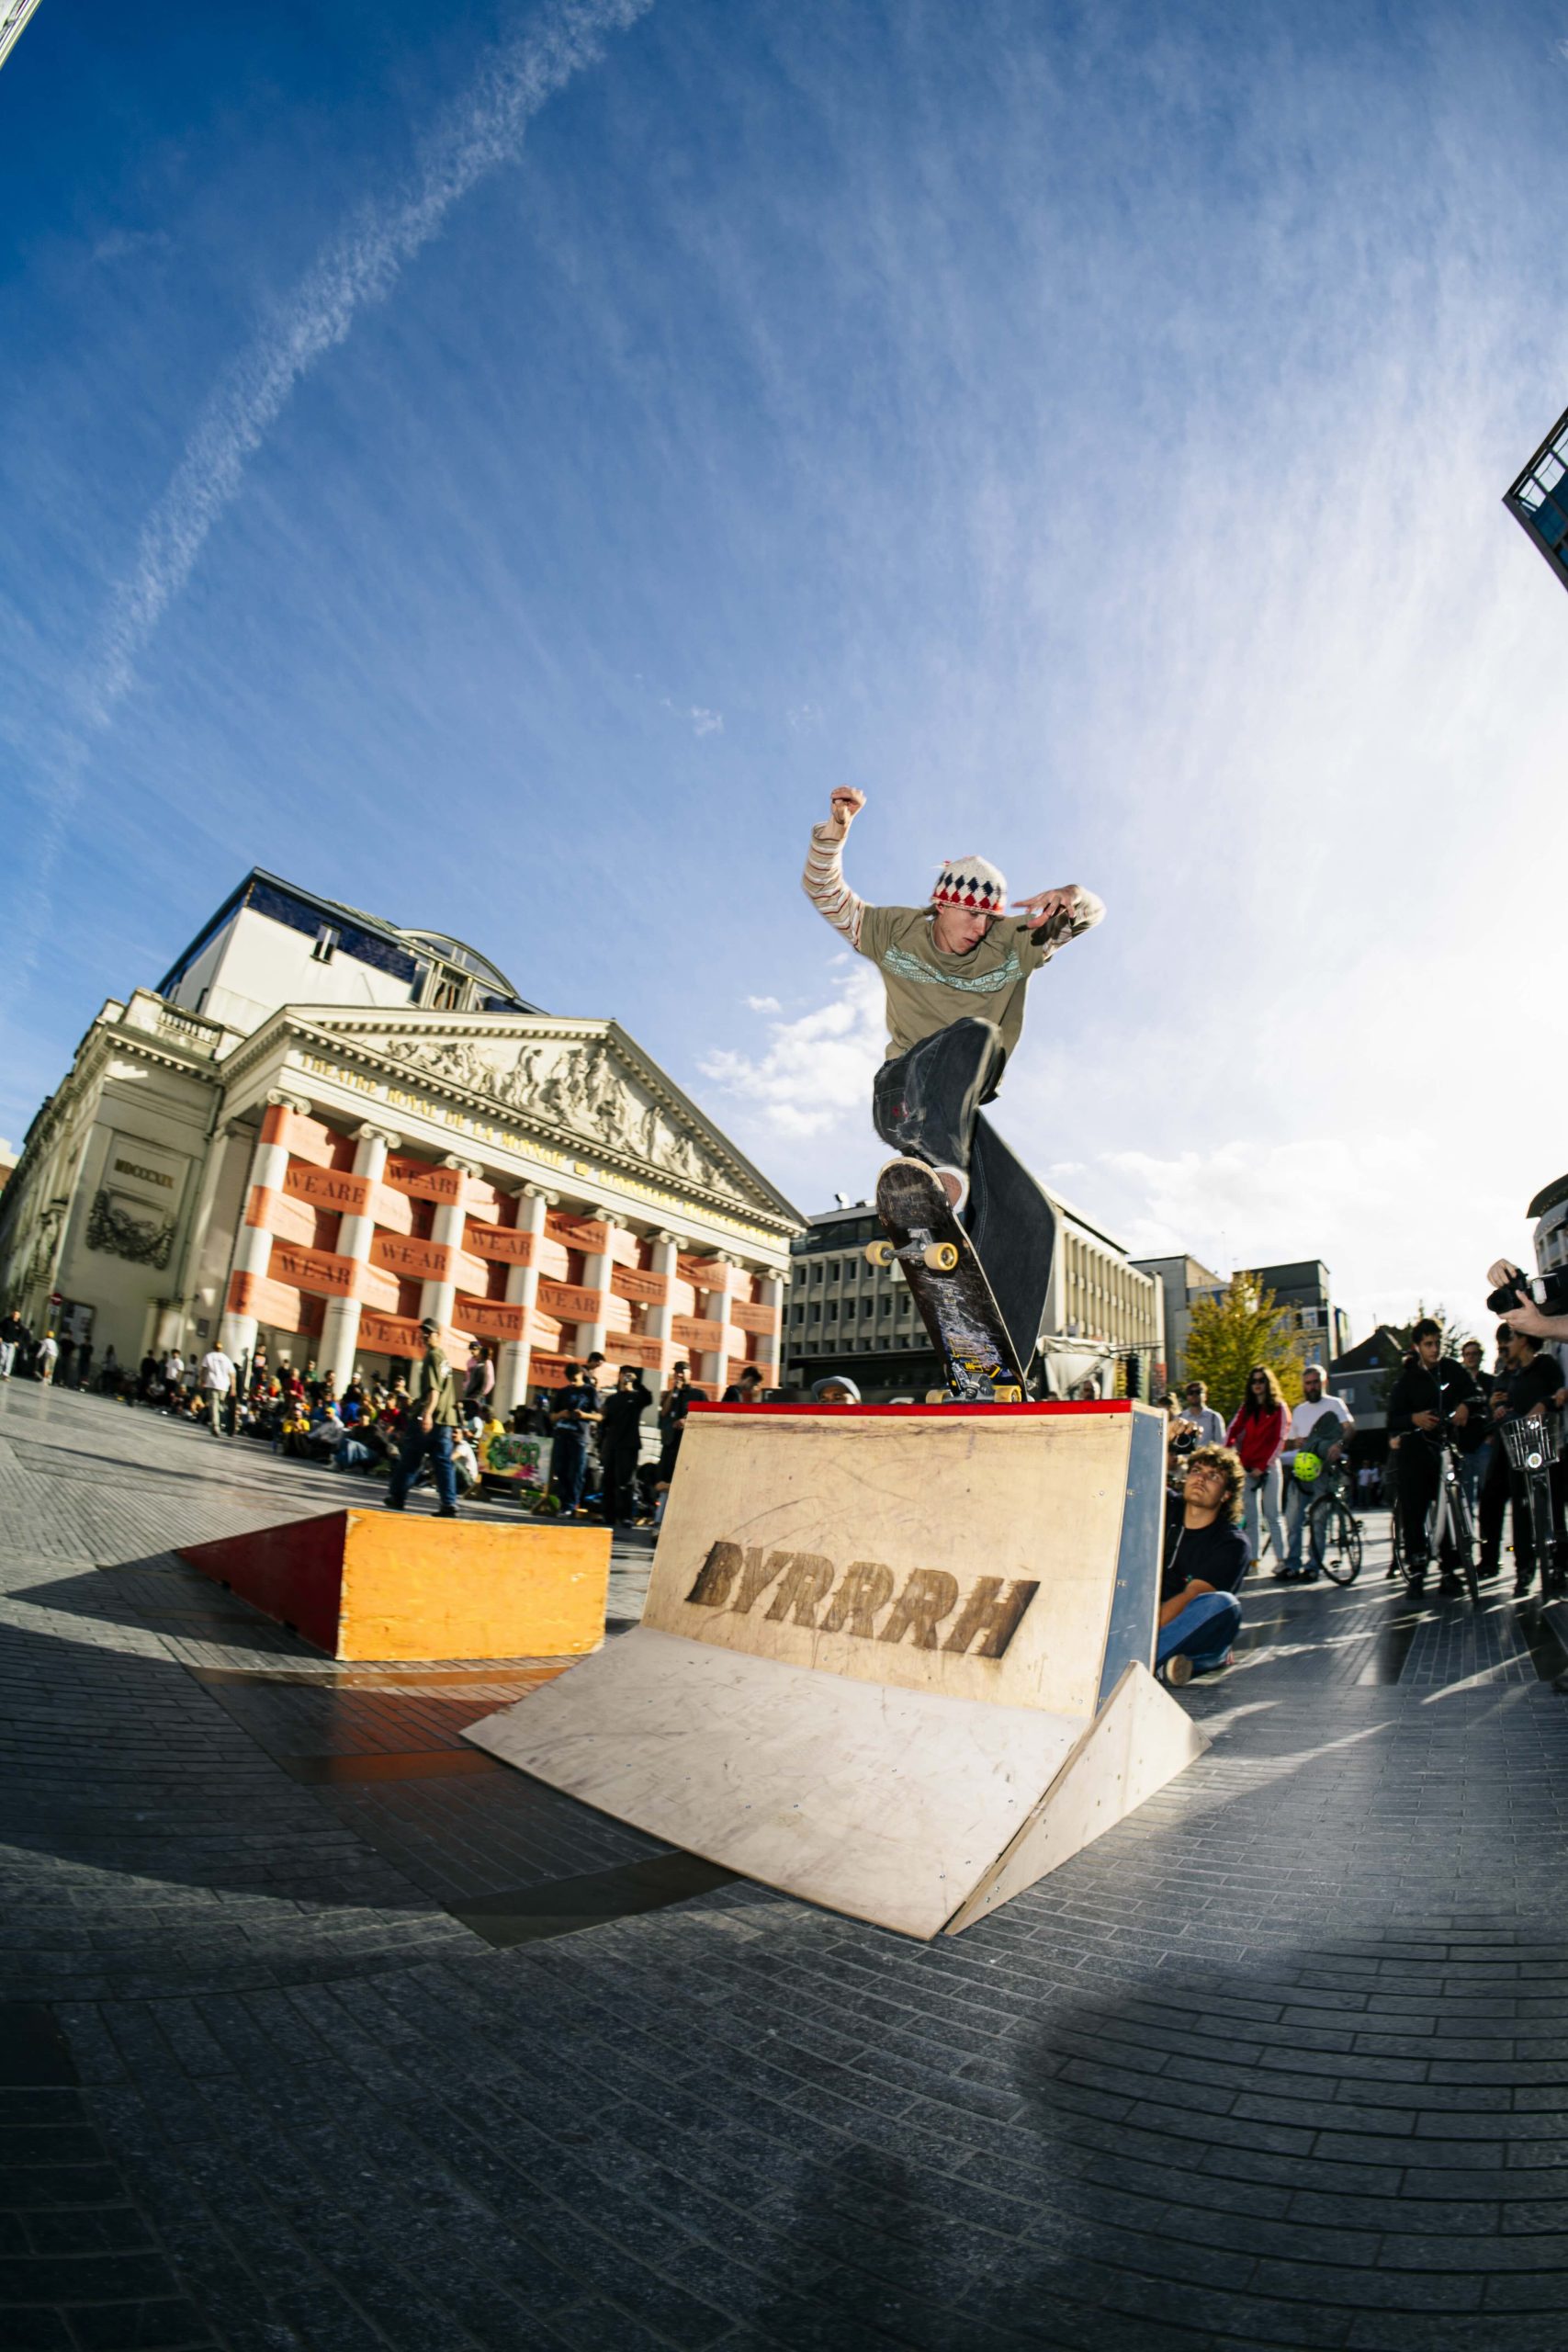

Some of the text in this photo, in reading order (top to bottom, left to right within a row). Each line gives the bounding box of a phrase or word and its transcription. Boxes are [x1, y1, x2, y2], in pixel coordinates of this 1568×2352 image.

[300, 1054, 378, 1094] THEATRE
[389, 1087, 436, 1119] ROYAL
[446, 1110, 465, 1130] DE
[321, 1182, 367, 1204] ARE
[382, 1242, 415, 1264] WE
[537, 1288, 568, 1307] WE
[685, 1541, 1041, 1659] BYRRRH
